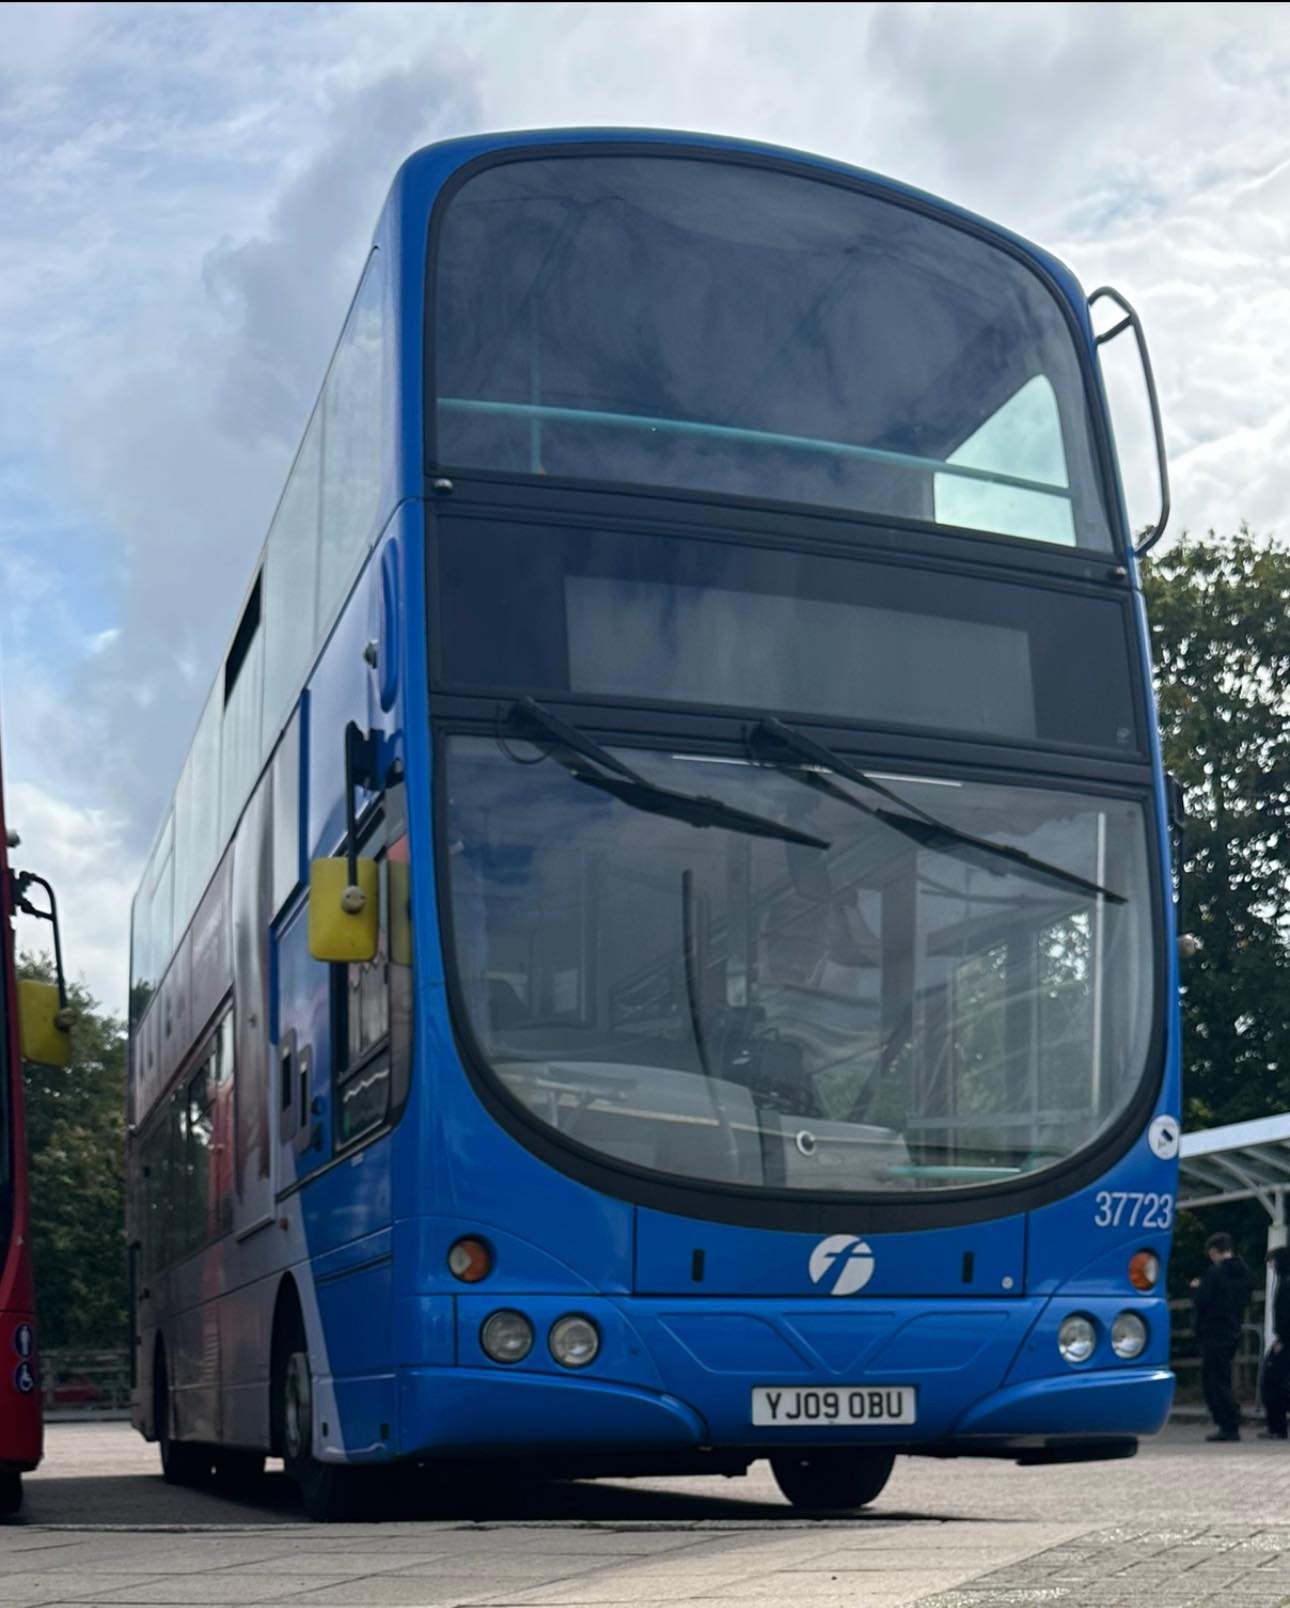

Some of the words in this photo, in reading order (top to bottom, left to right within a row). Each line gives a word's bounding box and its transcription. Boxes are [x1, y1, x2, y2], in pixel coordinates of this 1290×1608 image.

[1094, 1191, 1173, 1229] 37723
[765, 1391, 840, 1420] YJ09
[848, 1391, 903, 1419] OBU
